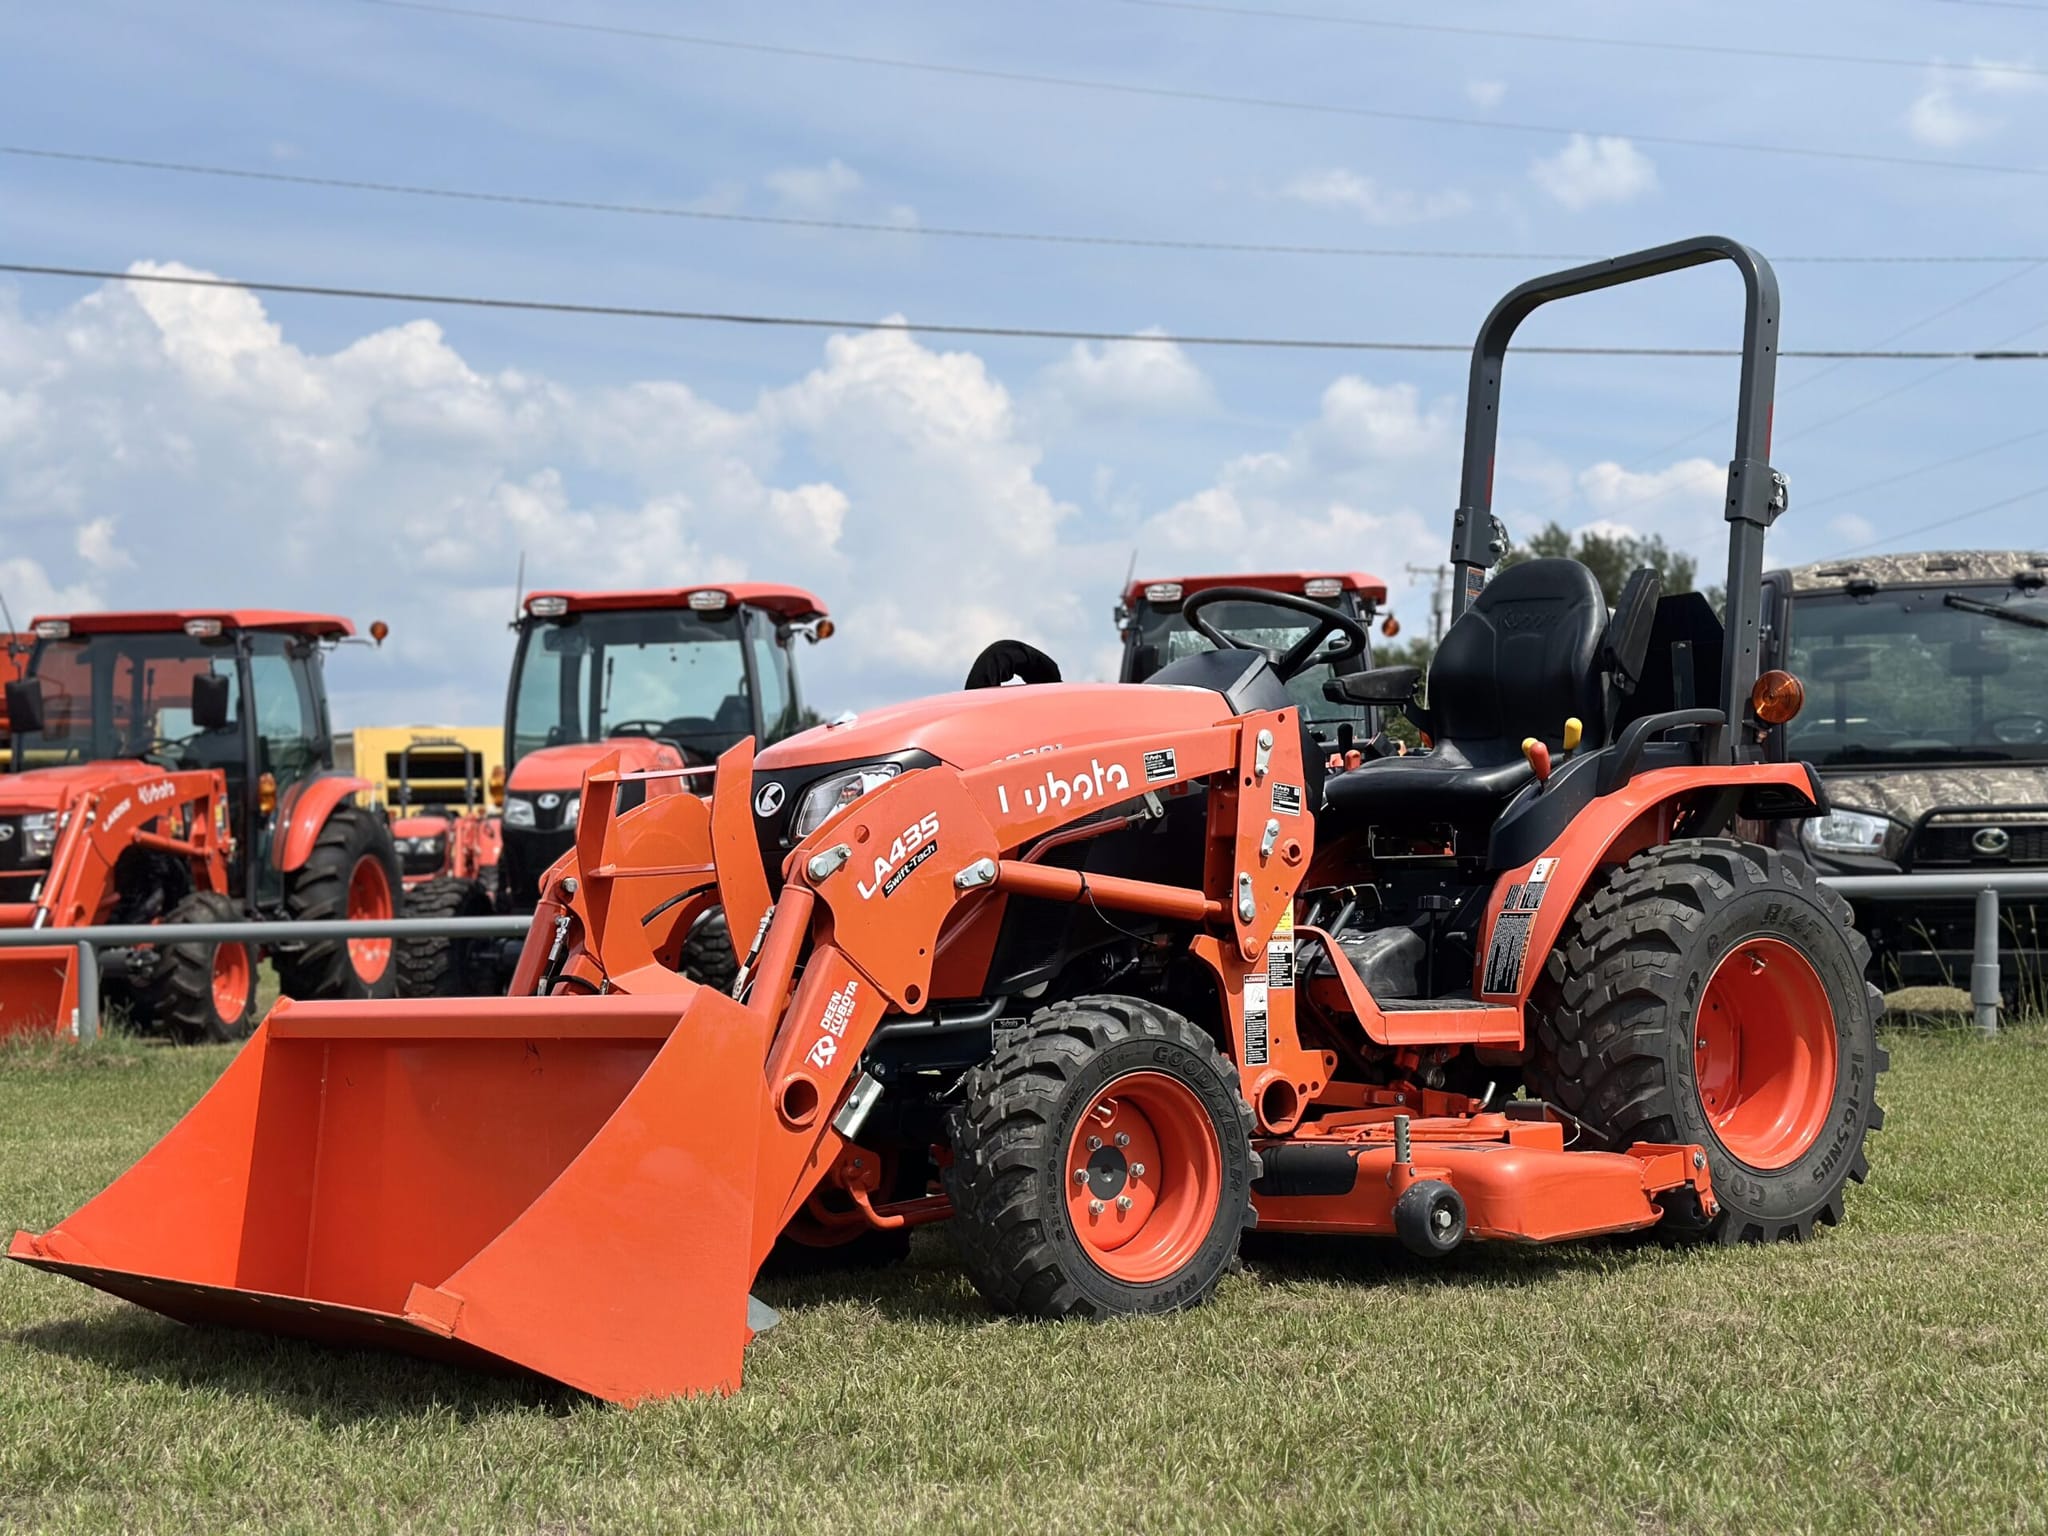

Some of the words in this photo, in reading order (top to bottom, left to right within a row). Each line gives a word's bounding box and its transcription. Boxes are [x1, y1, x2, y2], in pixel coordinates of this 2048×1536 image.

[857, 811, 940, 899] LA435
[884, 843, 936, 895] Swift-Tach
[820, 990, 843, 1031] DEEN
[829, 980, 859, 1036] KUBOTA
[1153, 1046, 1242, 1192] GOODYEAR
[1675, 971, 1766, 1207] GOOYEAR
